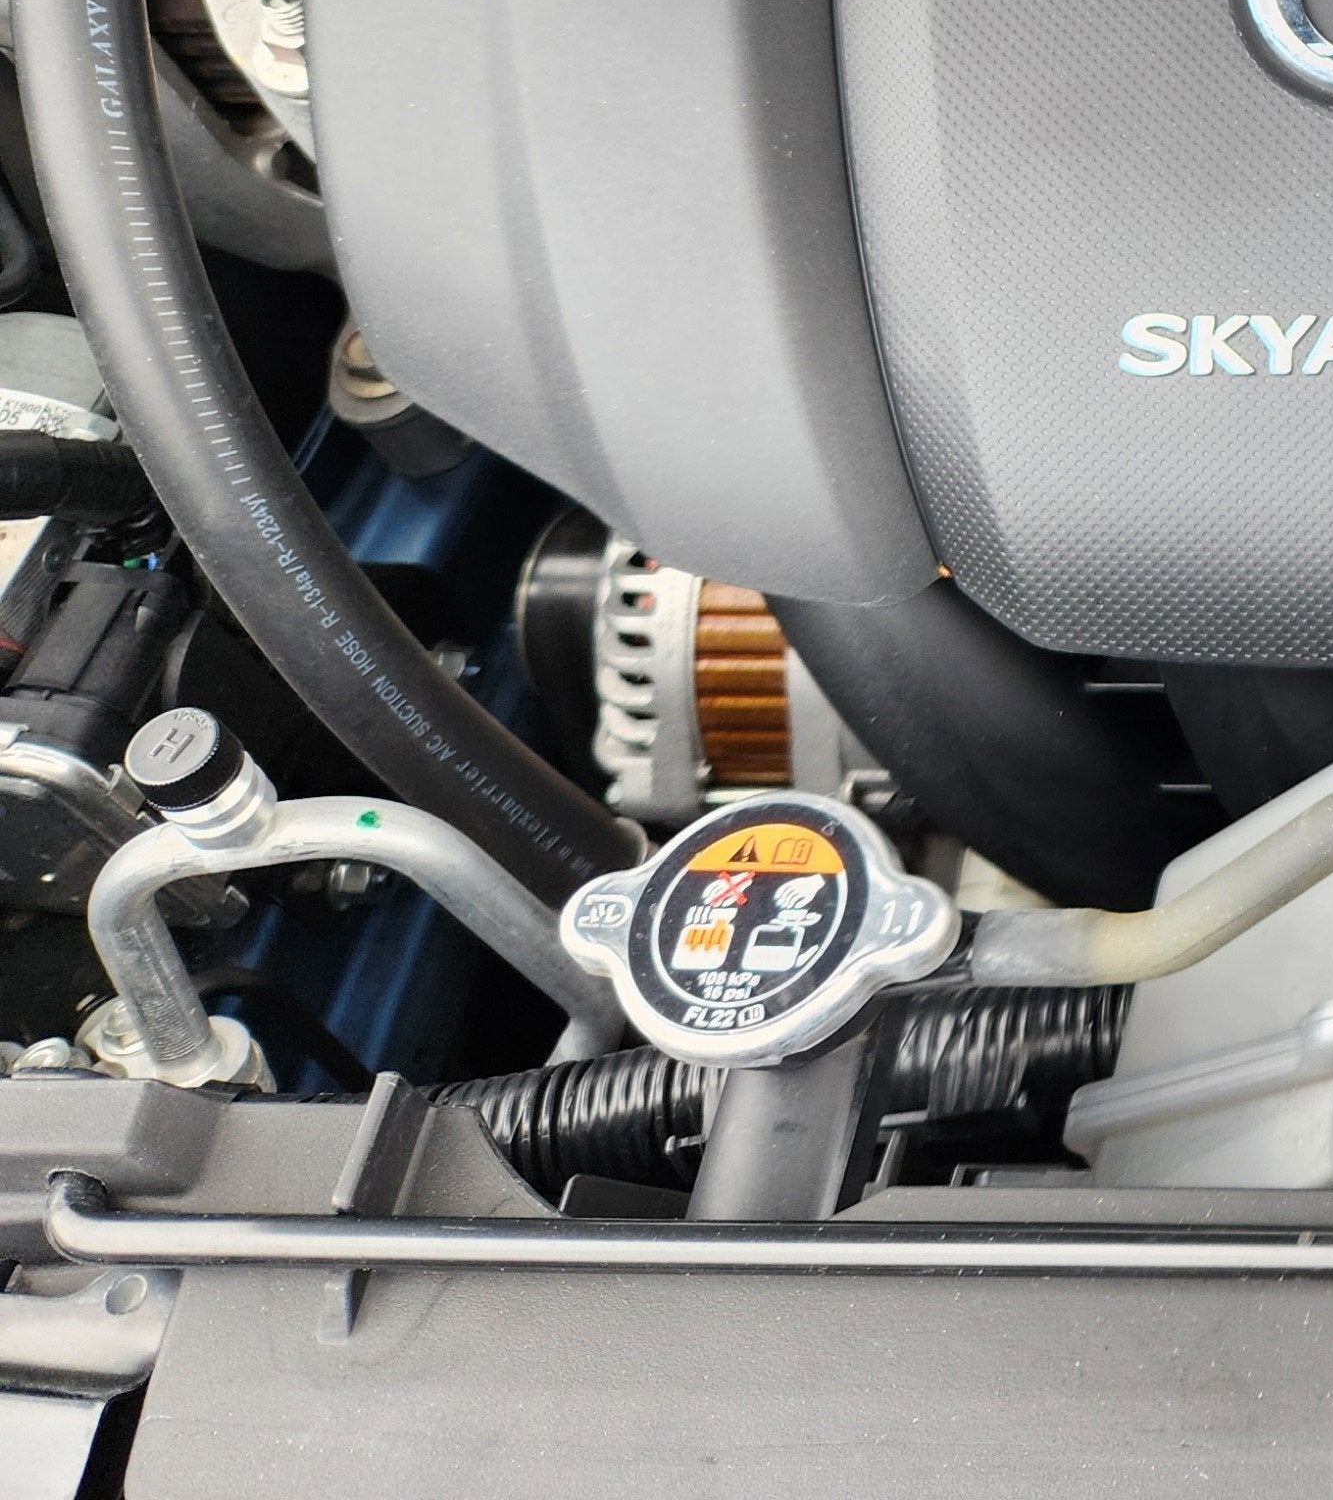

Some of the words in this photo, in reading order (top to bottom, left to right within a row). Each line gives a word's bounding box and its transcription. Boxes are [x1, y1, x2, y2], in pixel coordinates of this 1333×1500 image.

[240, 493, 340, 629] R-134a/R-1234yf
[335, 630, 377, 676] HOSE
[371, 675, 431, 738] SUCTION
[147, 727, 195, 763] H
[425, 734, 456, 763] A/C
[455, 760, 562, 851] Flexbarrier
[883, 900, 919, 935] 1.1
[722, 986, 752, 1001] psi
[681, 1006, 737, 1029] FL22
